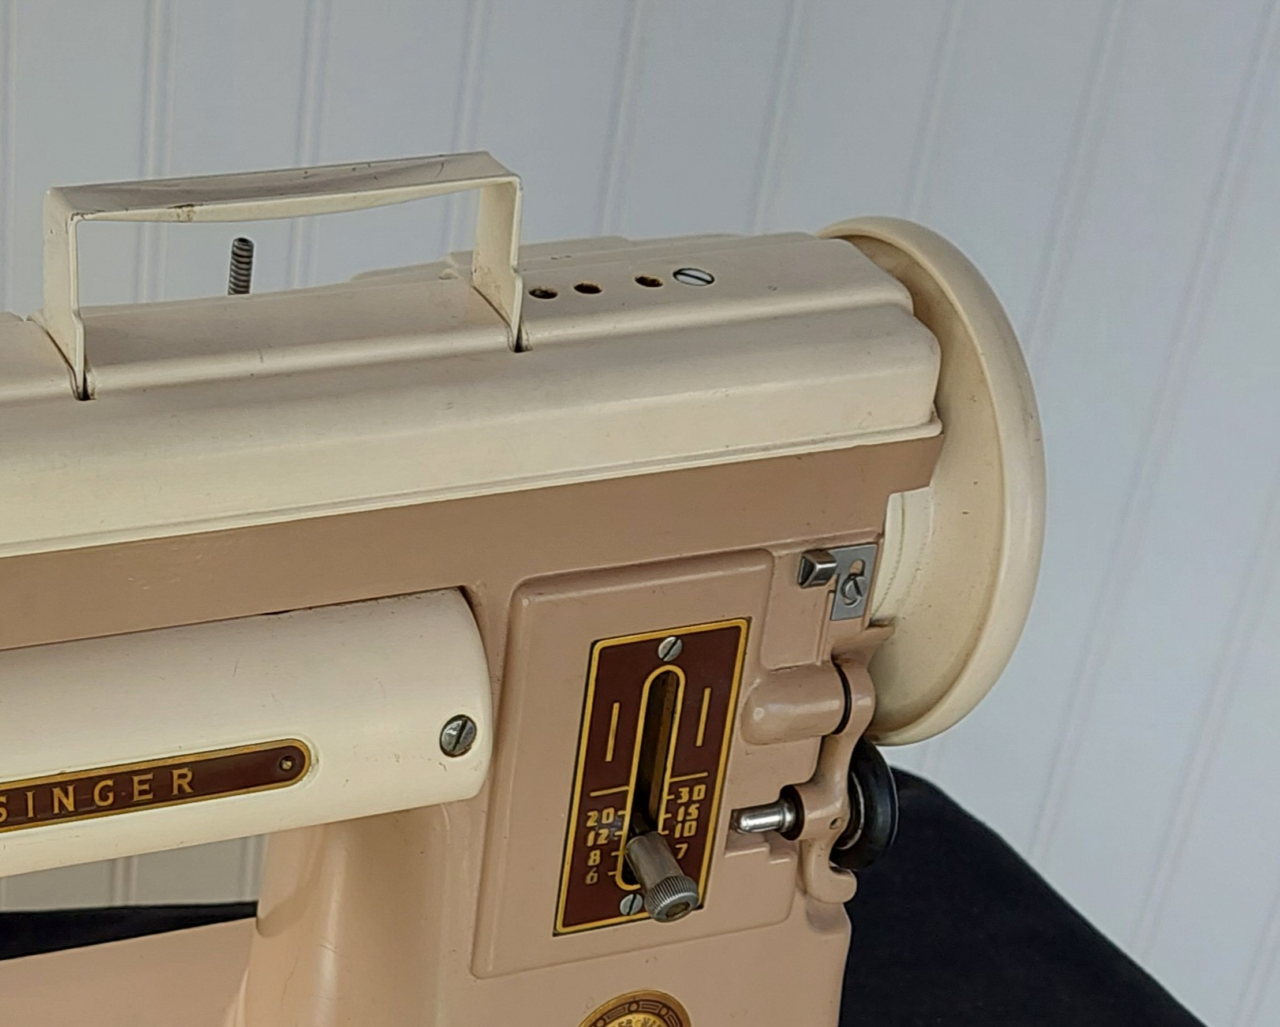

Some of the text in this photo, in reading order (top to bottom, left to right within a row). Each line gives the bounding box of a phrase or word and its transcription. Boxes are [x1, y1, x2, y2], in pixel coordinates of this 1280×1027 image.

[676, 783, 707, 804] 30
[585, 806, 616, 828] 20
[676, 803, 701, 822] 15
[585, 827, 610, 848] 12
[673, 820, 698, 839] 10
[587, 849, 601, 867] 8
[674, 842, 689, 860] 7
[585, 867, 599, 885] 6
